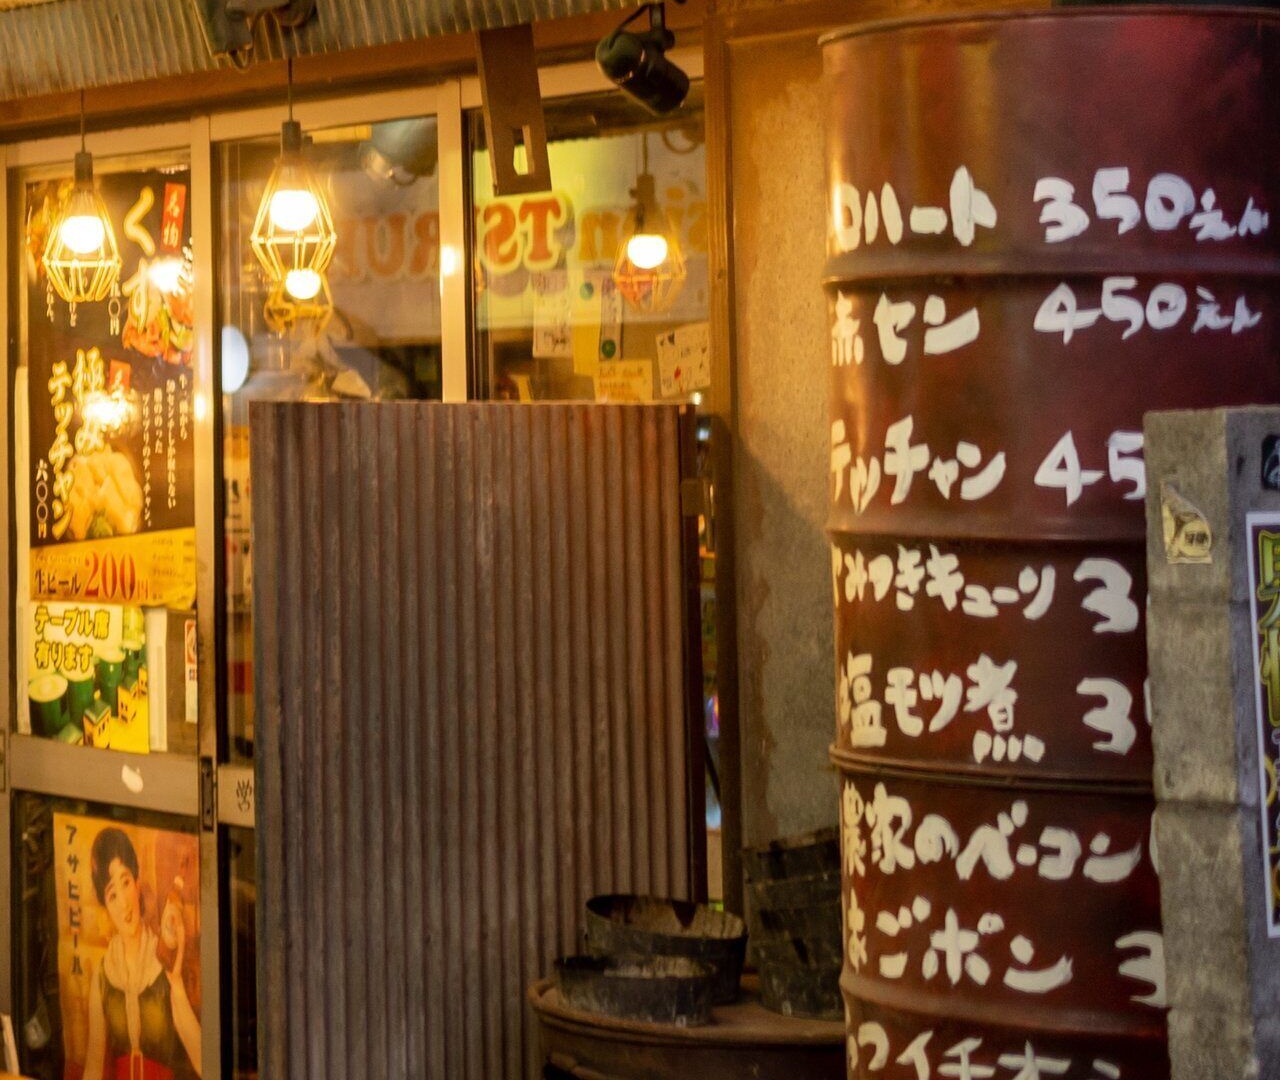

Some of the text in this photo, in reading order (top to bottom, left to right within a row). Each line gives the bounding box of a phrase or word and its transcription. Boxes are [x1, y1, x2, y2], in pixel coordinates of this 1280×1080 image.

[34, 639, 94, 673] 有ります
[65, 824, 83, 977] アサヒビール
